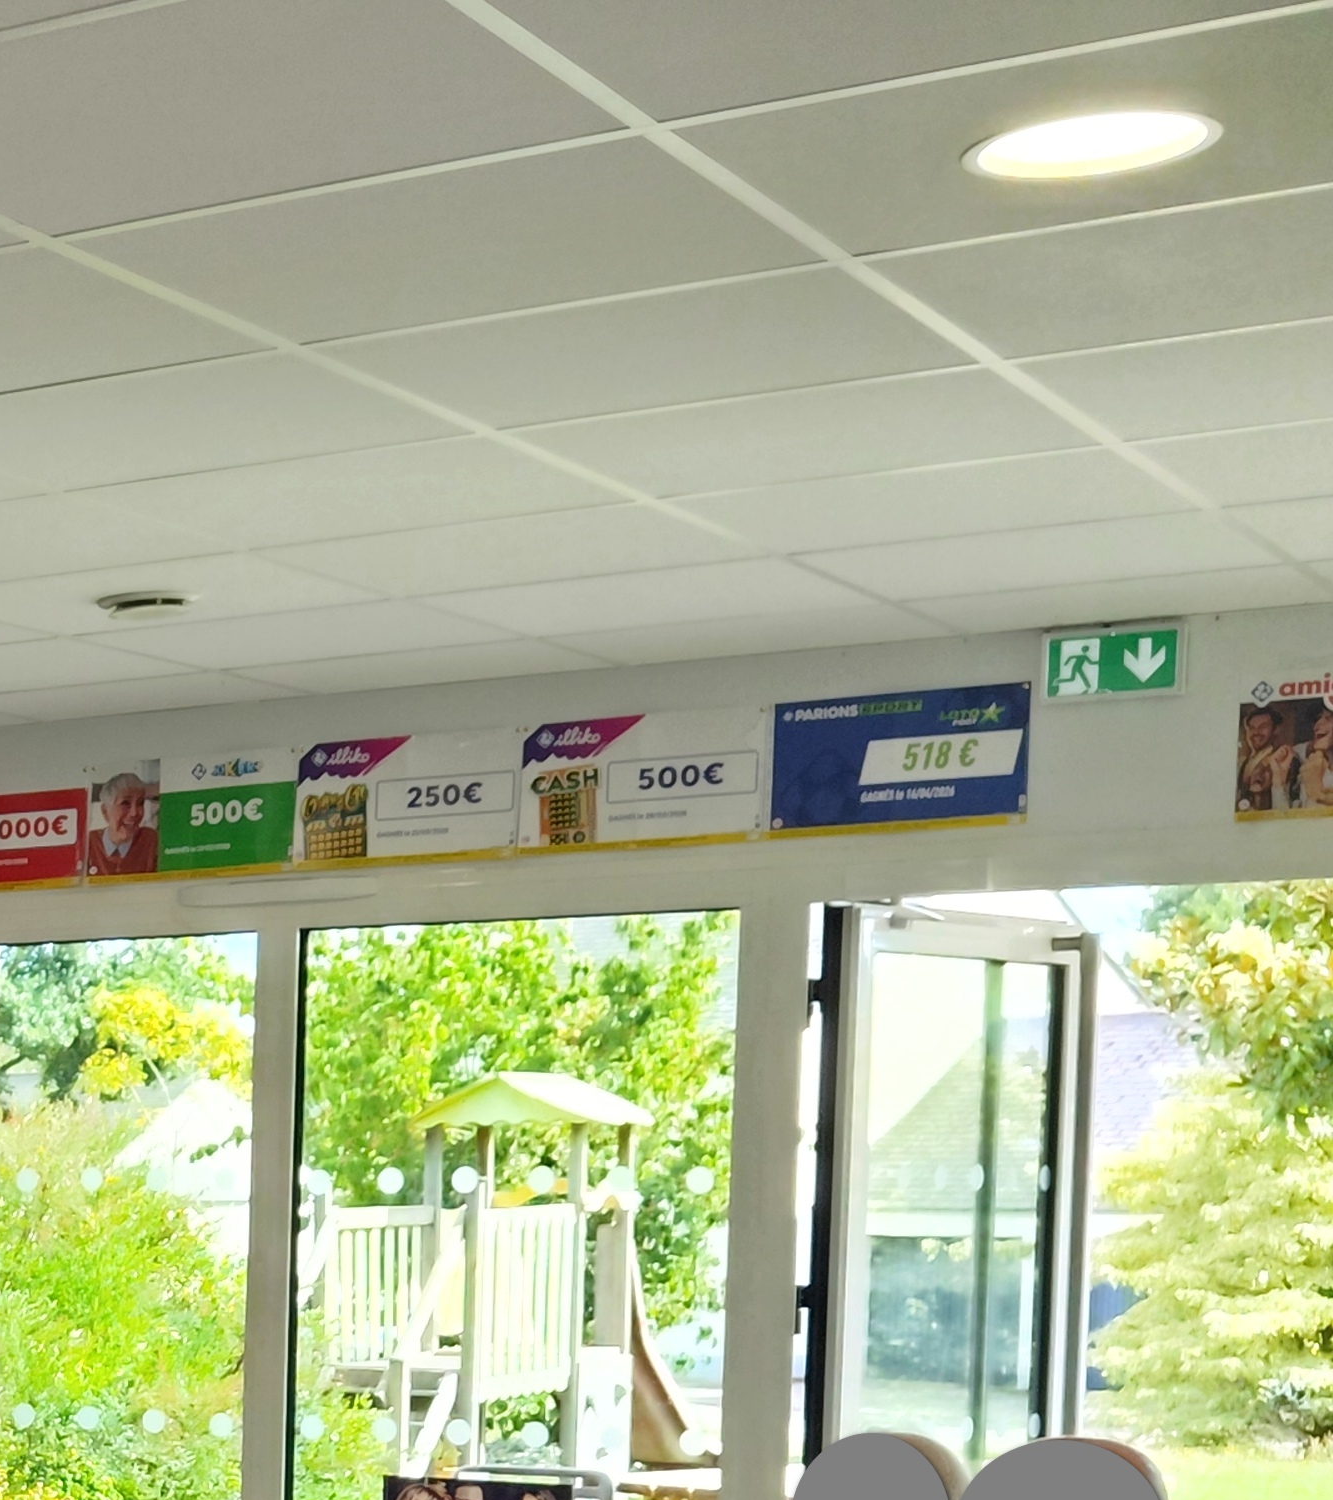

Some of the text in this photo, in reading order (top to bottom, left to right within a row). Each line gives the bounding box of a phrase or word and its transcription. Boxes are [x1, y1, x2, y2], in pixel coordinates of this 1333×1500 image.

[1279, 673, 1333, 706] ami
[795, 704, 858, 722] PARIONS
[903, 739, 979, 771] 518 €
[531, 768, 598, 795] CASH
[638, 762, 724, 790] 500€
[407, 782, 483, 809] 250€
[190, 798, 264, 828] 500€
